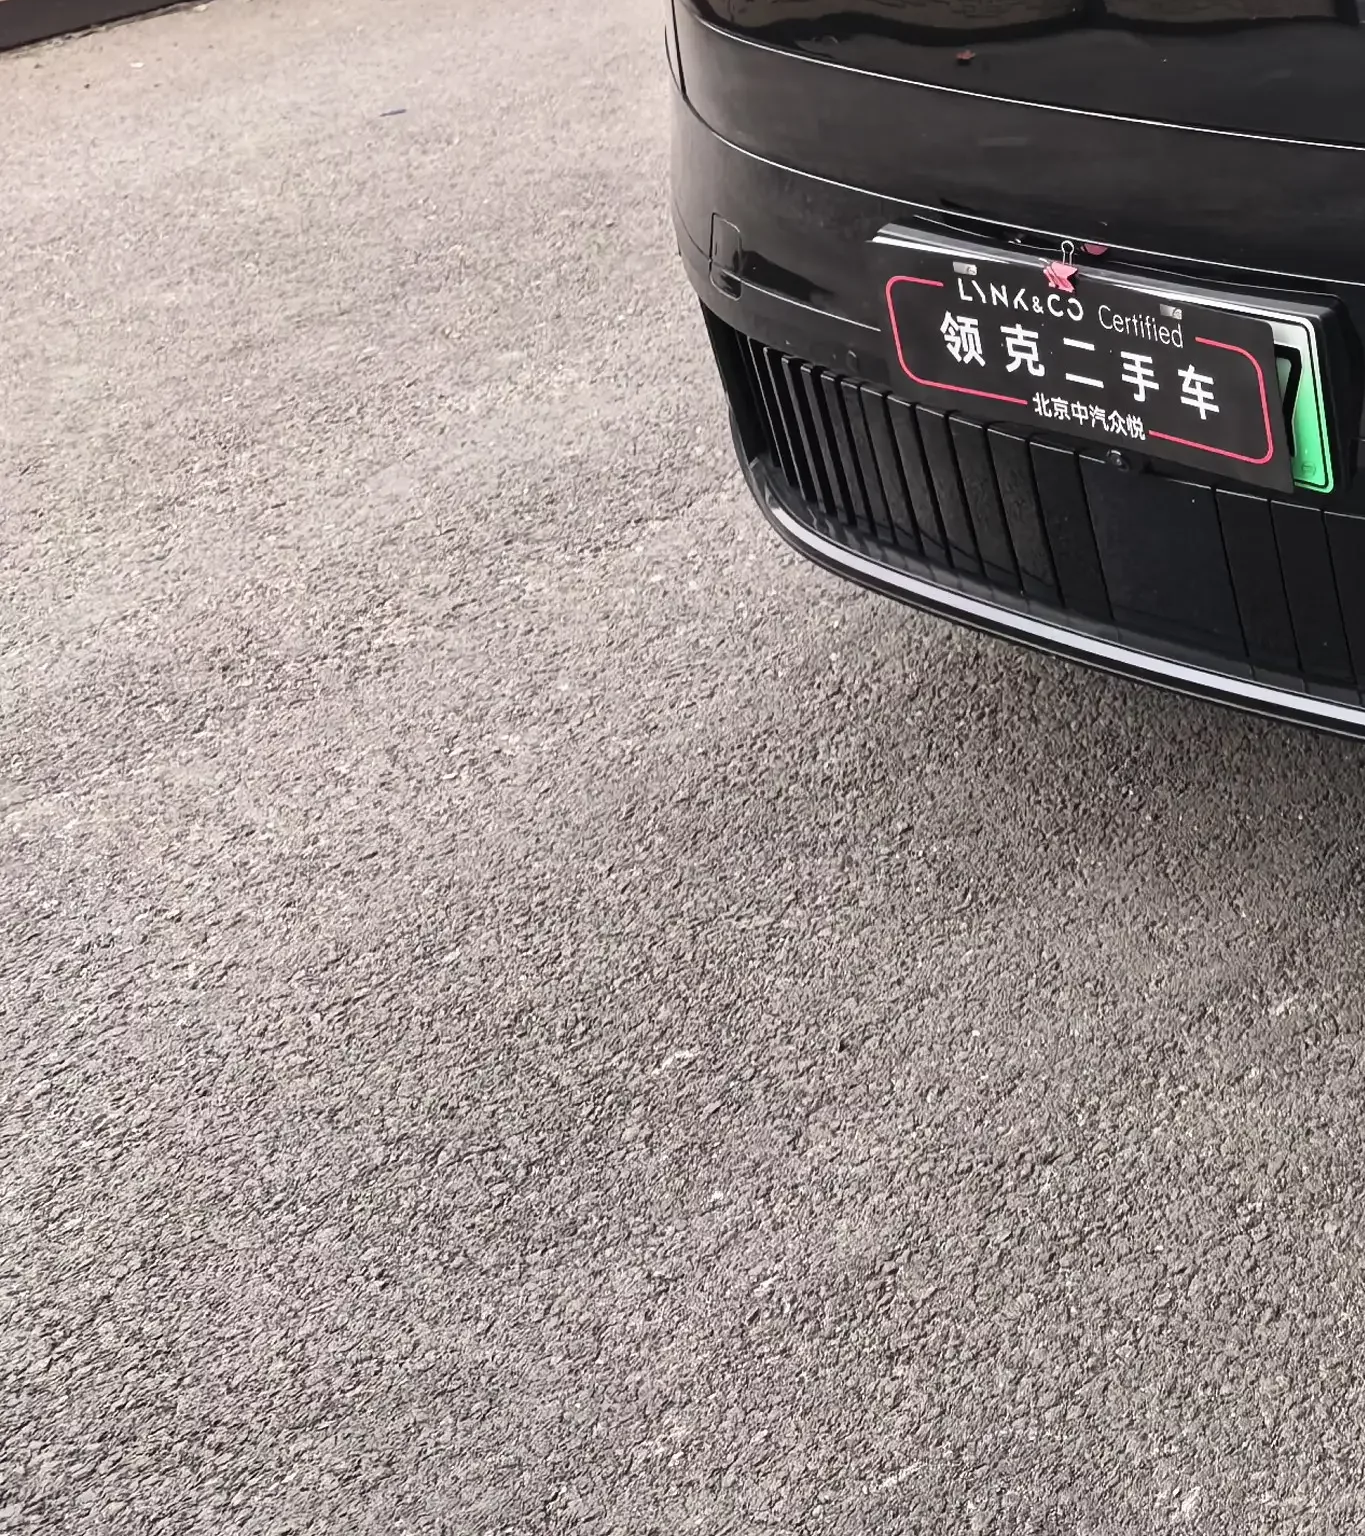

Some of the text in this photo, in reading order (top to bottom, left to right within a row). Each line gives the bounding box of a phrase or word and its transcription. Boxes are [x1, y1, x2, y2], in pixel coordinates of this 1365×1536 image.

[956, 277, 1184, 349] LYNK&CO Certified
[939, 310, 1220, 421] 领克二手车
[1031, 391, 1146, 442] 北京中汽众悦
